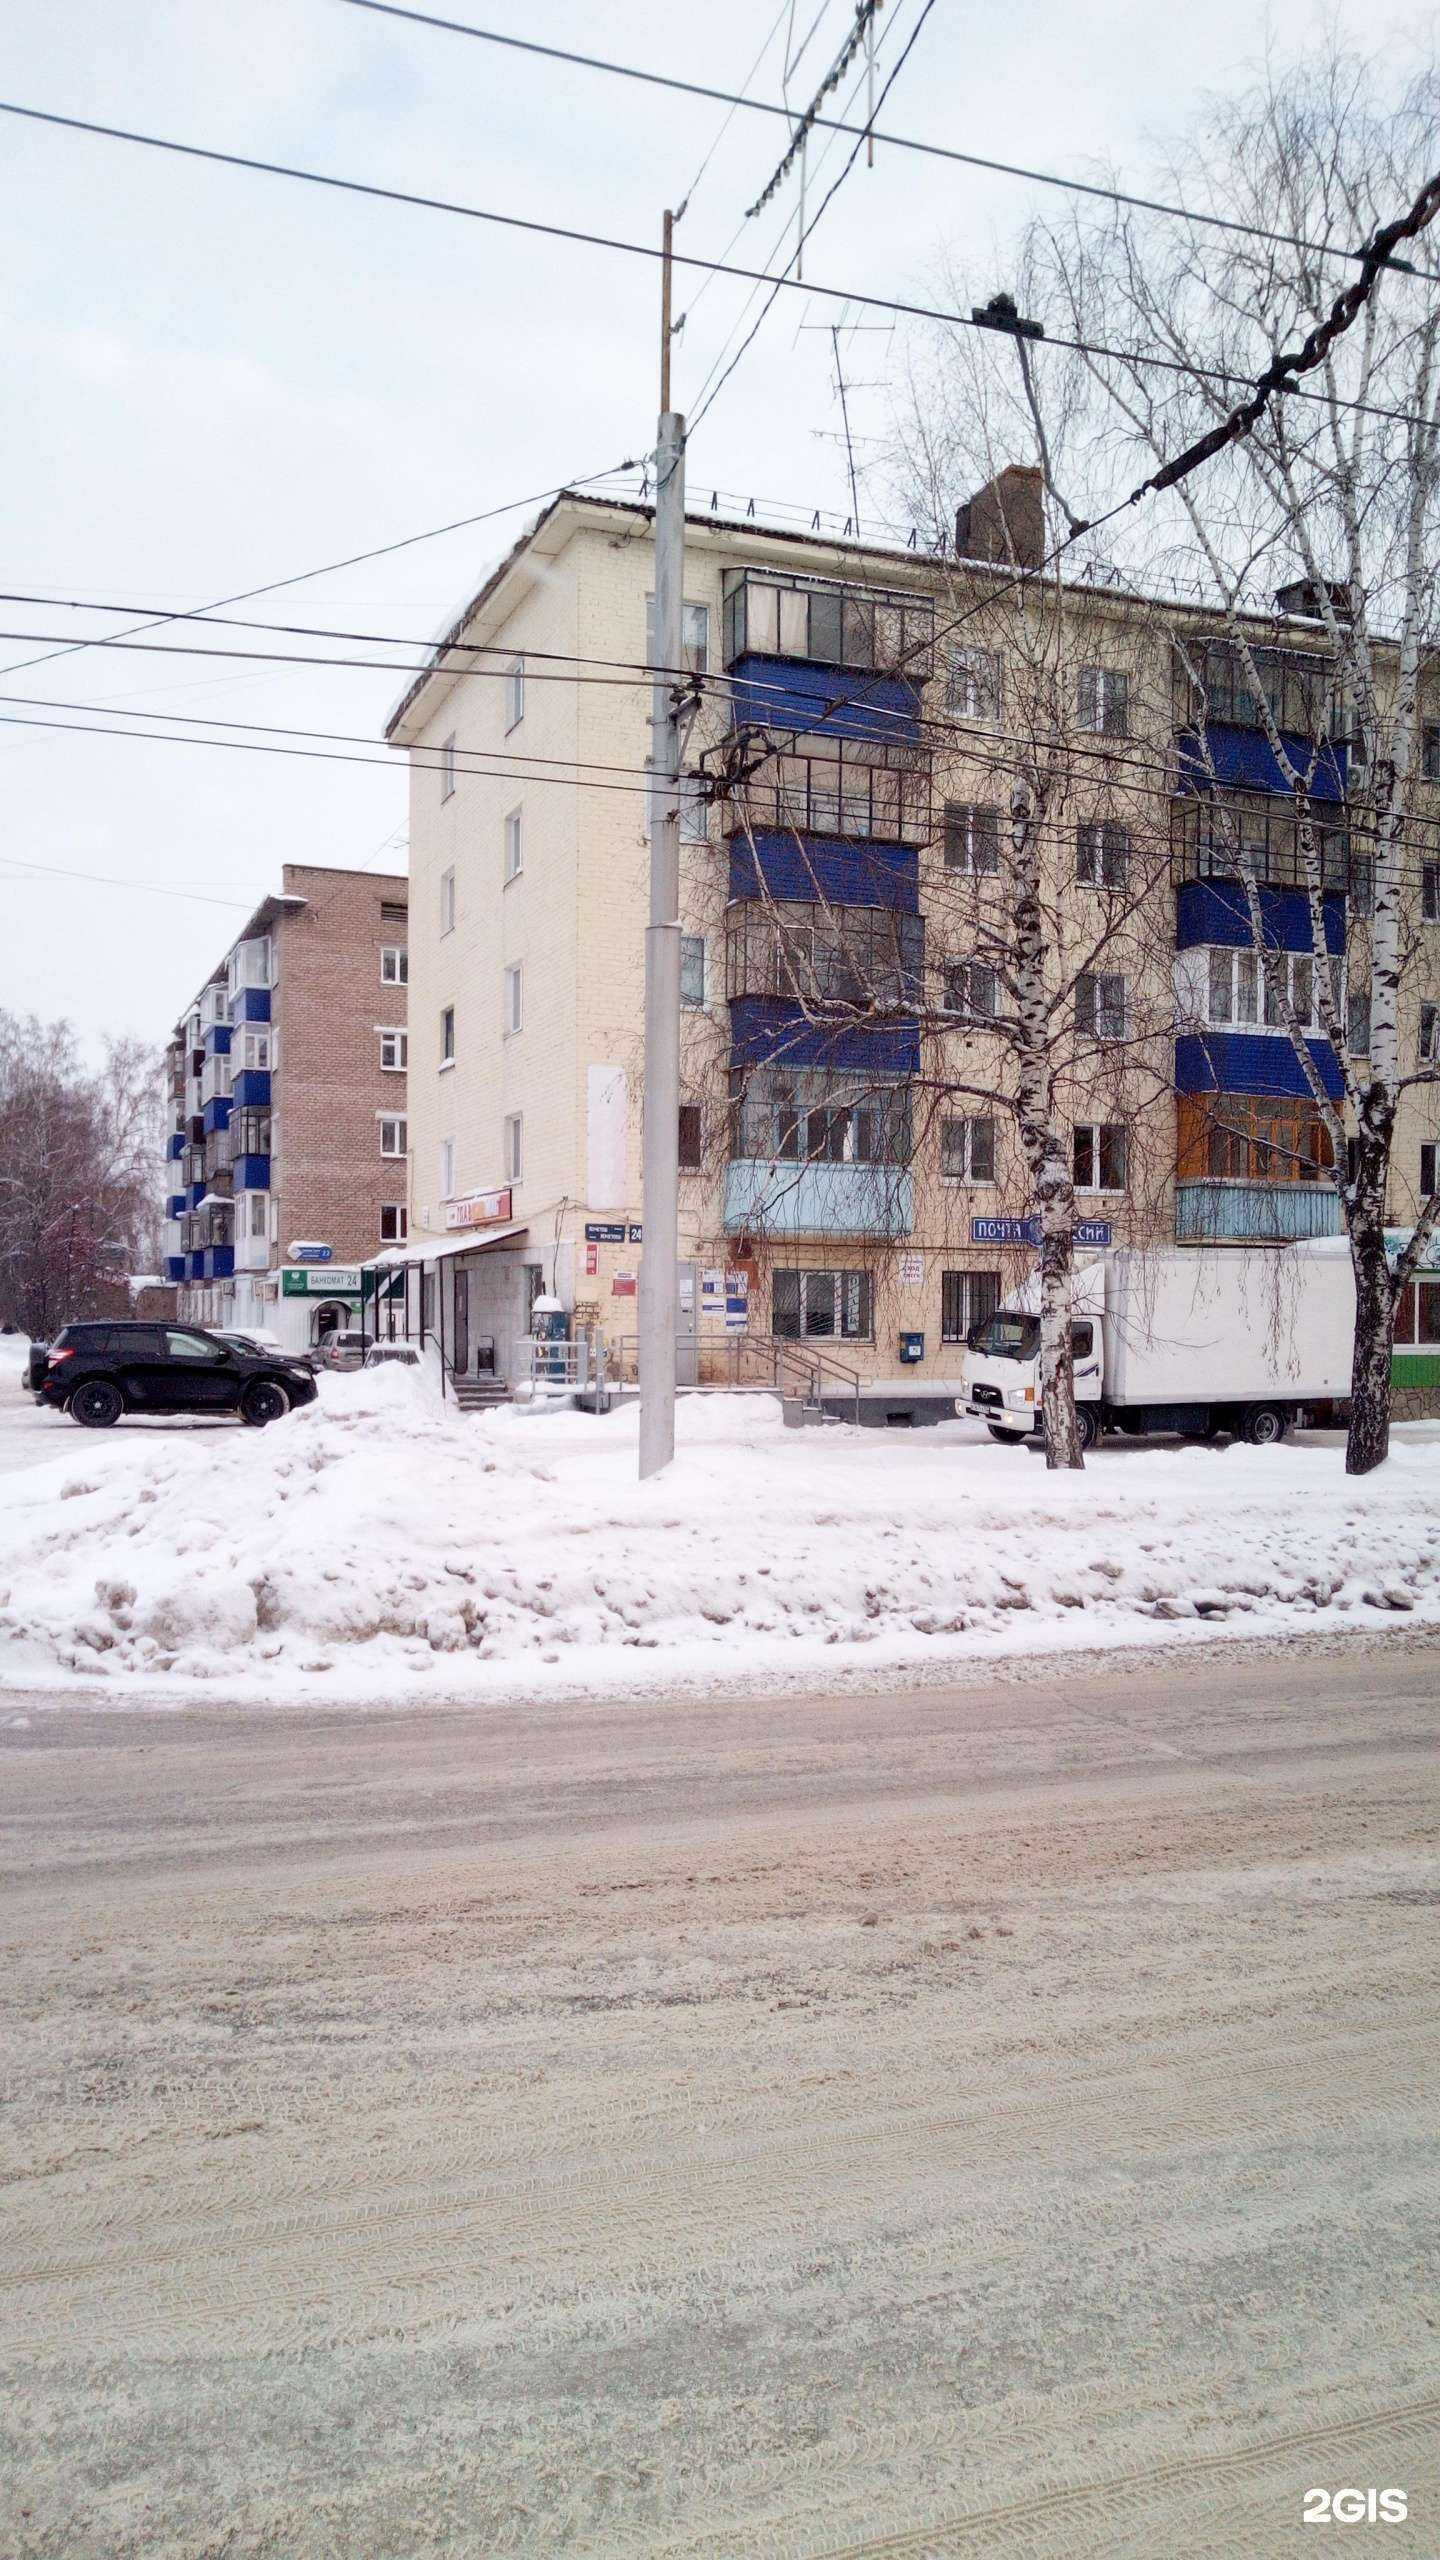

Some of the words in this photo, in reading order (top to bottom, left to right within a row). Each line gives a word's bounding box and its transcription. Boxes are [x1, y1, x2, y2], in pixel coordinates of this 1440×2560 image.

[631, 1228, 642, 1240] 24
[978, 1222, 1021, 1238] ПОЧТА
[310, 1276, 344, 1285] БАНКОМАТ
[347, 1275, 357, 1286] 24
